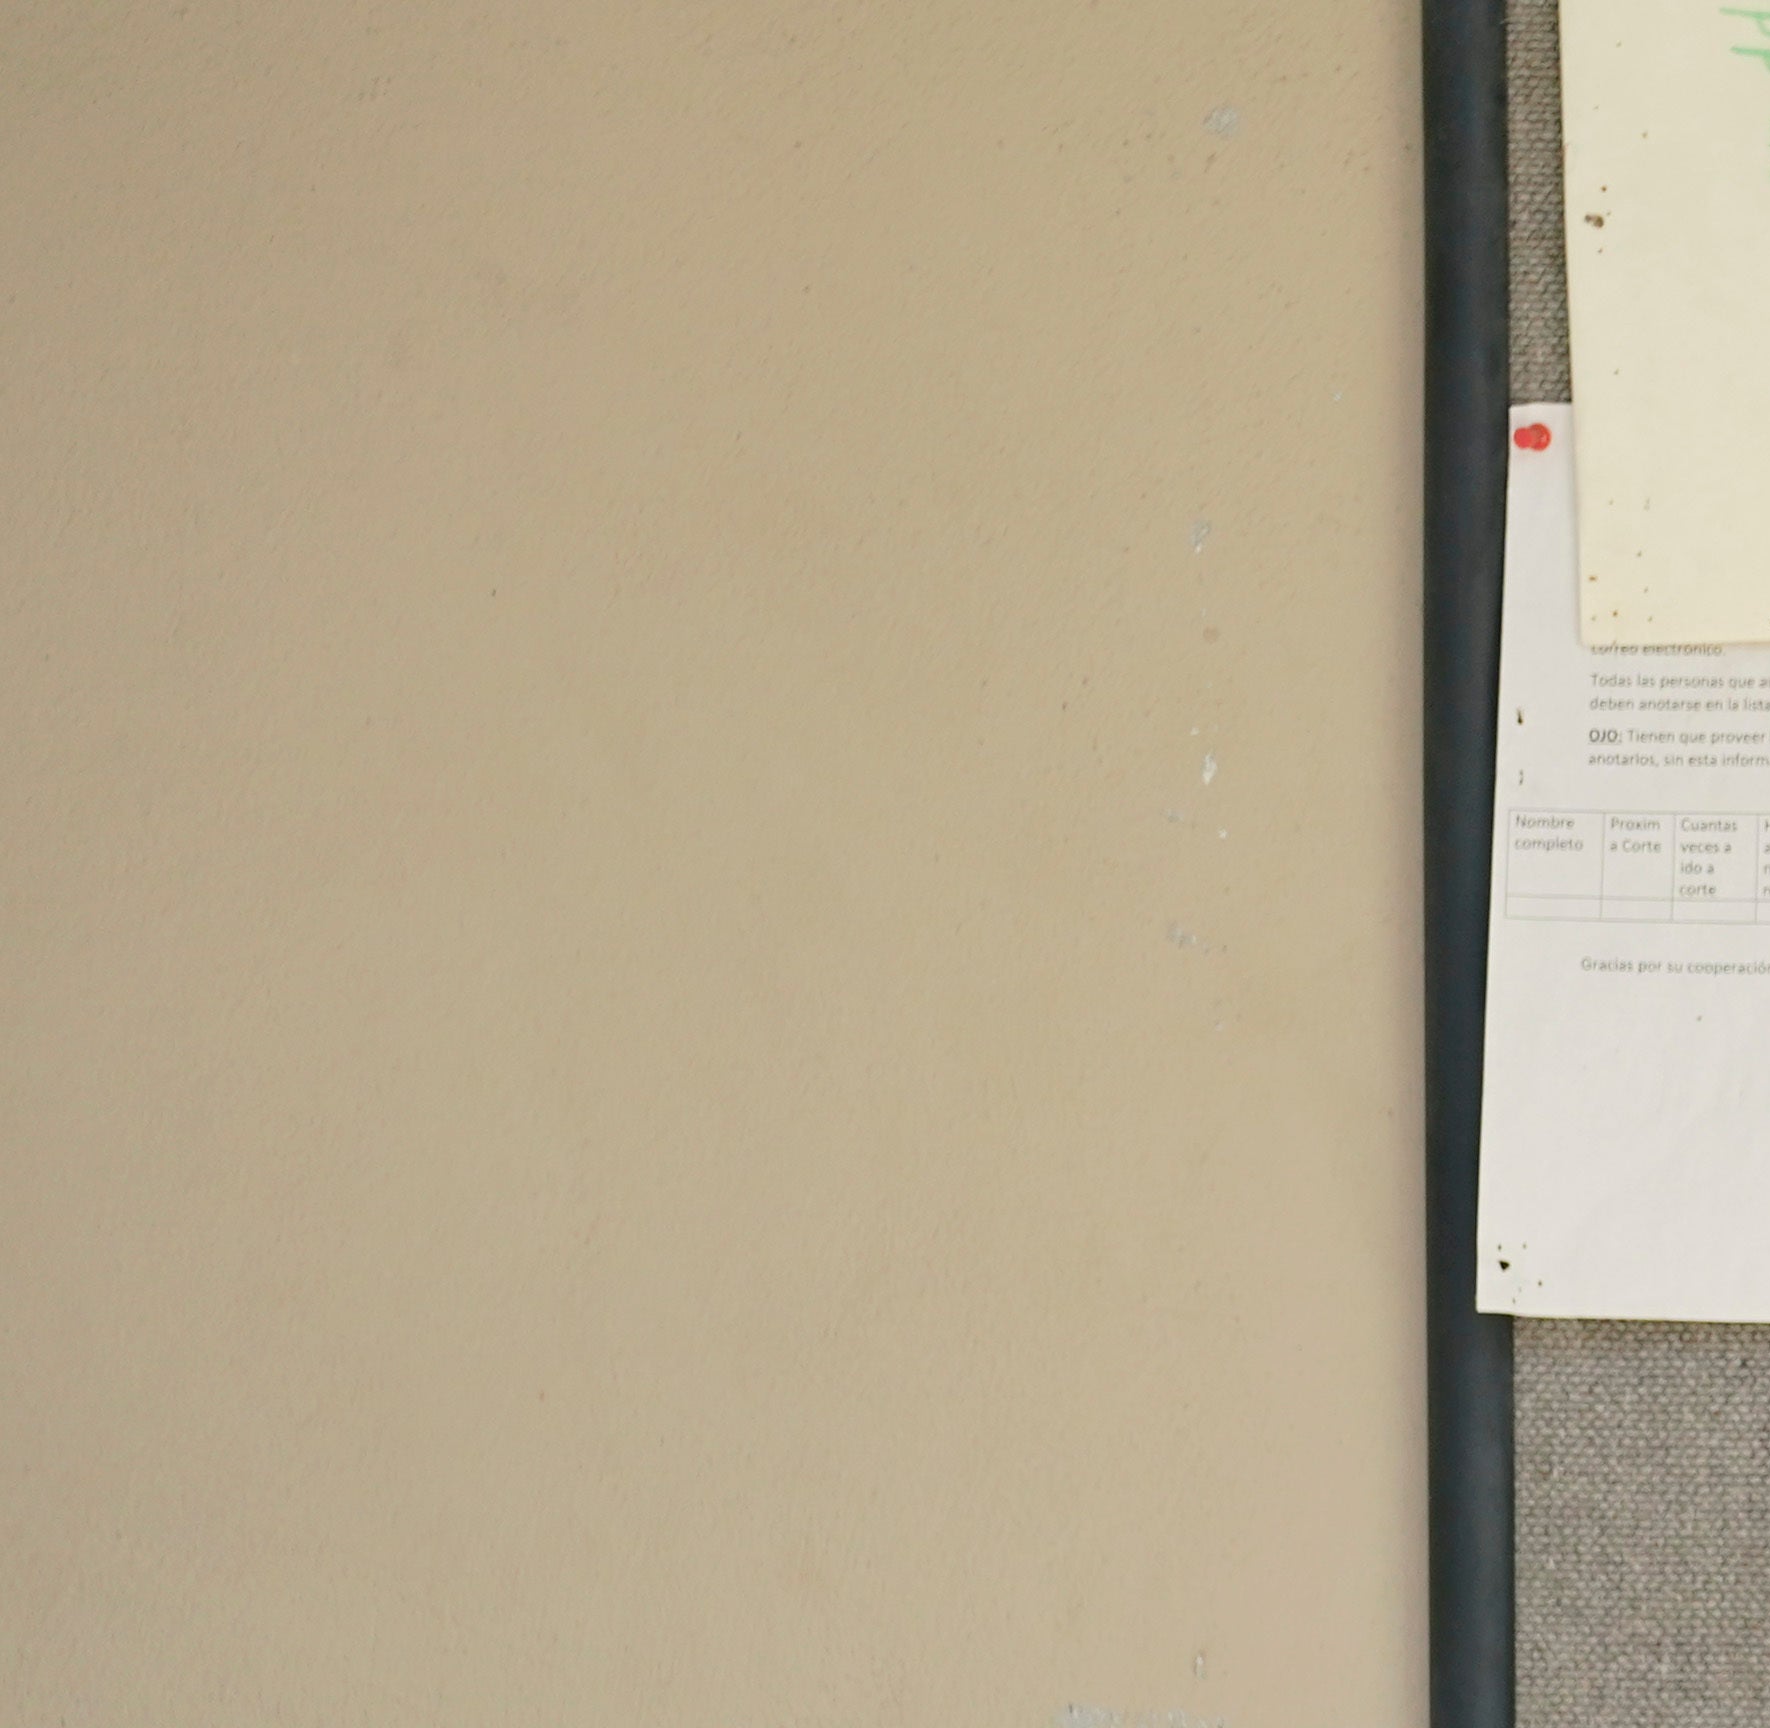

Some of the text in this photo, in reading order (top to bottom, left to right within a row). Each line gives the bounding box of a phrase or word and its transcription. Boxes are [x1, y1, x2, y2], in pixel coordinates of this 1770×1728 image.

[1590, 674, 1631, 688] Todas
[1637, 674, 1655, 688] las
[1660, 677, 1723, 691] personas
[1728, 677, 1755, 692] que
[1590, 697, 1634, 711] deben
[1639, 699, 1701, 712] anotarse
[1706, 701, 1723, 712] en
[1728, 698, 1739, 711] la
[1588, 729, 1622, 746] OJO:
[1627, 730, 1675, 744] Tienen
[1679, 733, 1706, 748] que
[1710, 733, 1765, 748] proveer
[1664, 755, 1684, 768] sin
[1688, 756, 1717, 768] esta
[1515, 815, 1575, 829] Nombre
[1610, 817, 1661, 831] Proxim
[1681, 817, 1738, 832] Cuantas
[1514, 834, 1584, 852] completo
[1610, 840, 1662, 853] a Corte
[1680, 842, 1732, 854] veces a
[1680, 861, 1715, 875] ido a
[1679, 884, 1717, 896] corte
[1581, 957, 1633, 973] Gracias
[1638, 961, 1662, 976] por
[1667, 962, 1683, 973] su
